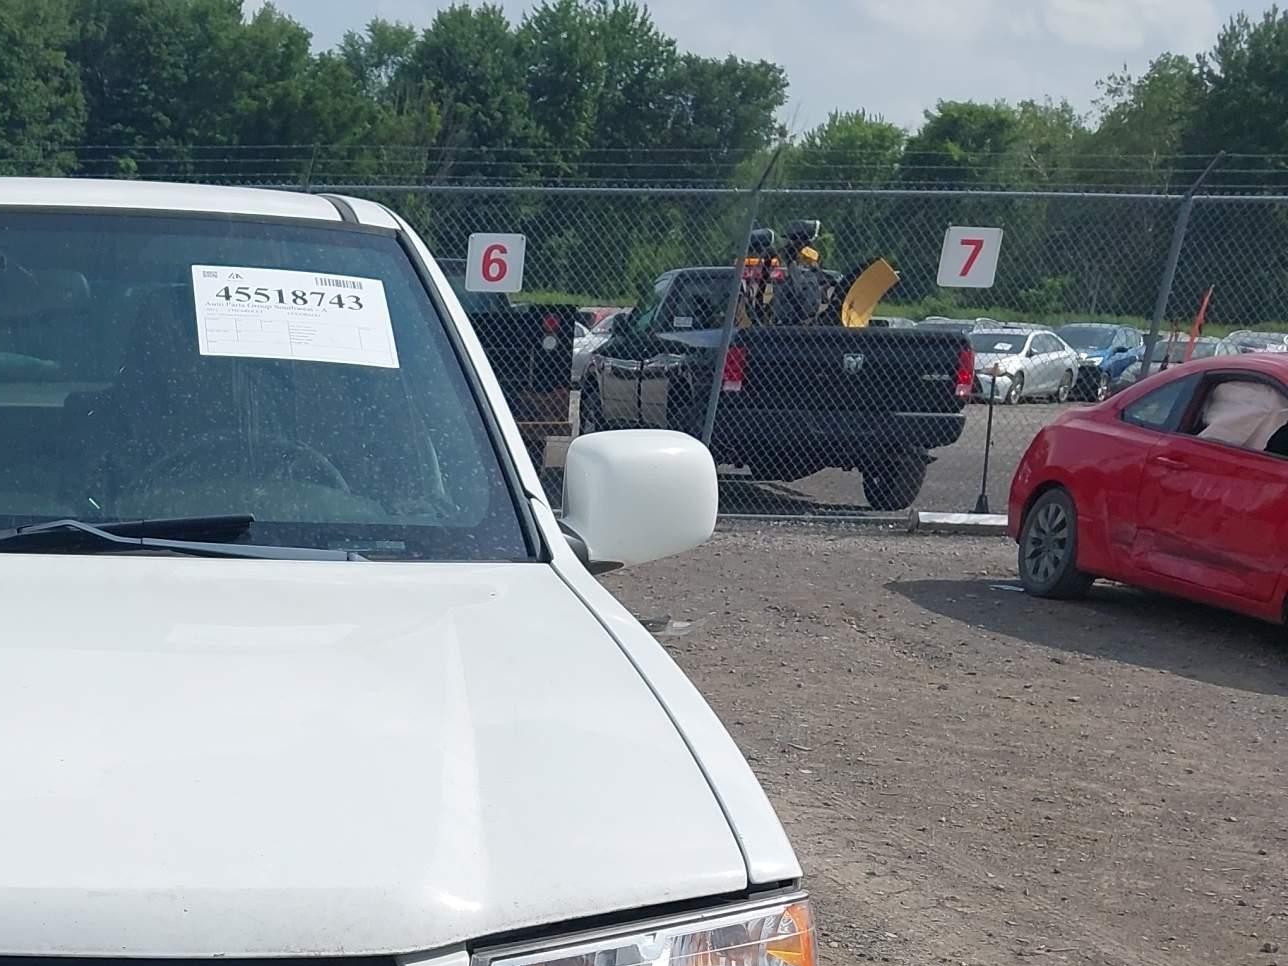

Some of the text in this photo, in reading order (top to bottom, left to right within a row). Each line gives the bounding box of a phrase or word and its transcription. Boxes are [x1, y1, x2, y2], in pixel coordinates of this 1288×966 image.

[482, 244, 508, 282] 6
[959, 239, 985, 277] 7
[215, 286, 364, 311] 45518743
